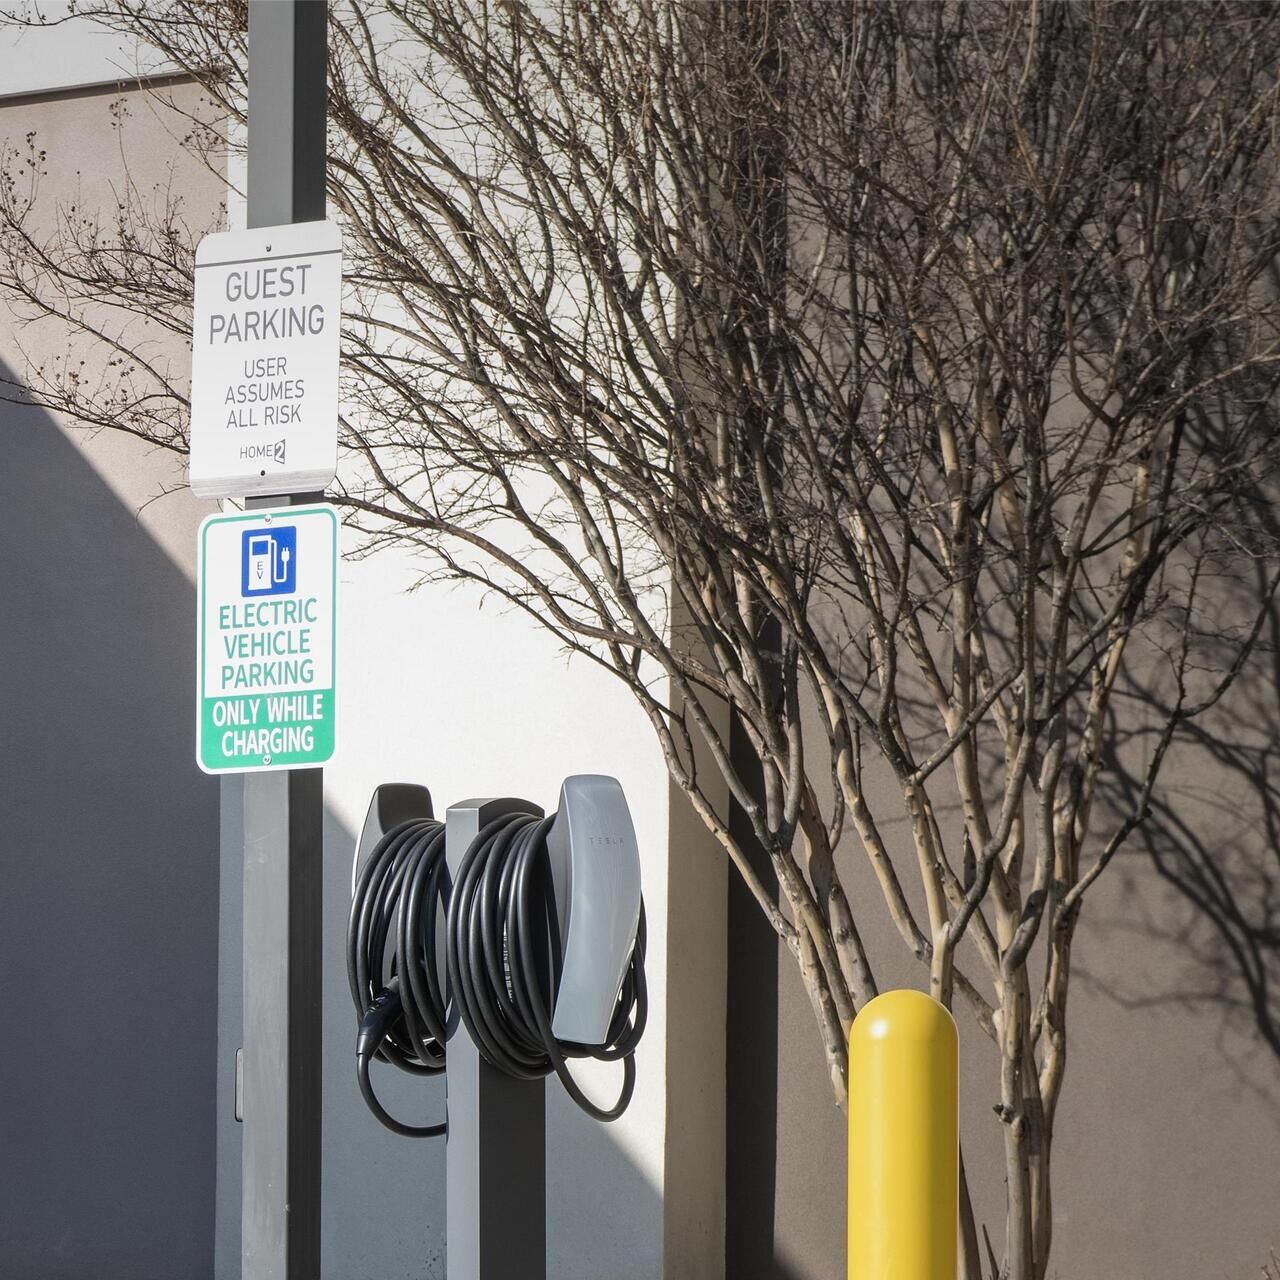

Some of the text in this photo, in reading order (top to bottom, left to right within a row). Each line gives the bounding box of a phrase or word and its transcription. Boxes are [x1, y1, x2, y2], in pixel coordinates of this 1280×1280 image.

[226, 264, 312, 302] GUEST
[210, 304, 325, 344] PARKING
[244, 357, 287, 378] USER
[225, 379, 305, 405] ASSUMES
[226, 404, 302, 428] ALL RISK
[219, 597, 317, 630] ELECTRIC
[224, 629, 310, 659] VEHICLE
[221, 659, 314, 689] PARKING
[212, 694, 323, 727] ONLY WHILE
[221, 726, 314, 757] CHARGING
[589, 836, 624, 845] TESLA
